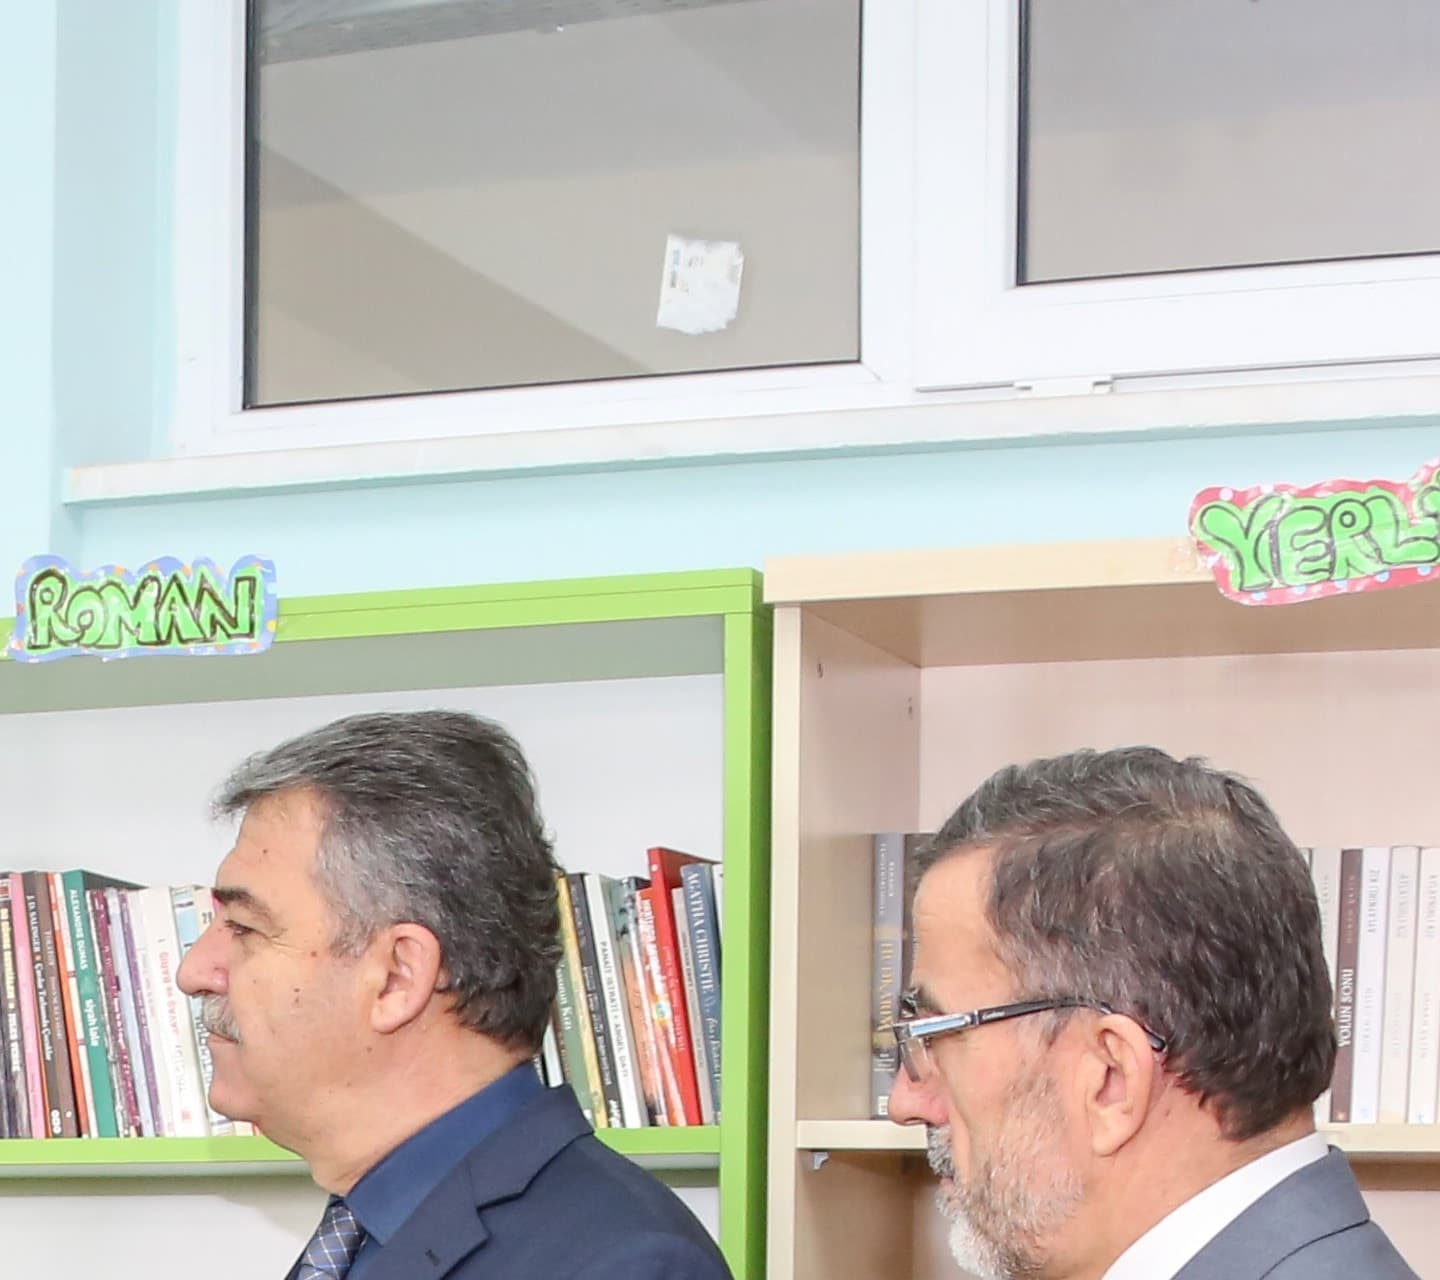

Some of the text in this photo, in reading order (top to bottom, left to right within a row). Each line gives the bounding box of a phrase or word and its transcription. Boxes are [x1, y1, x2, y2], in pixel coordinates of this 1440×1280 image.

[27, 568, 257, 650] ROMAN
[687, 873, 714, 993] AGATHA CHRISTIE
[1338, 969, 1354, 1047] YOLUN SONU
